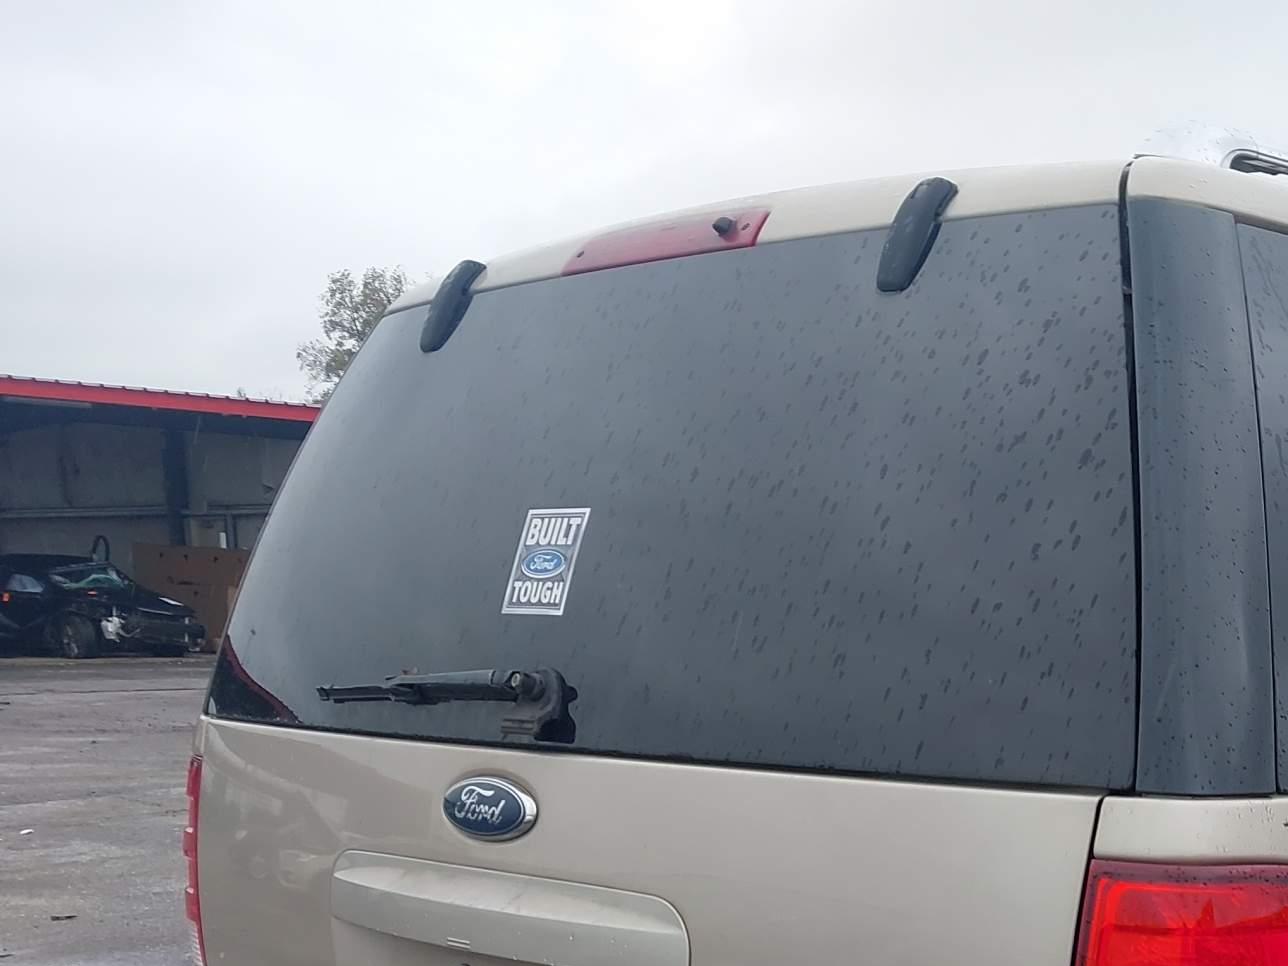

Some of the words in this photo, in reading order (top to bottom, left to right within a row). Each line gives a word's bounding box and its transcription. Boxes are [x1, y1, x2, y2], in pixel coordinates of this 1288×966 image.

[525, 517, 582, 546] BUILT
[529, 554, 558, 570] Ford
[511, 580, 564, 604] TOUGH
[454, 785, 506, 825] Ford
